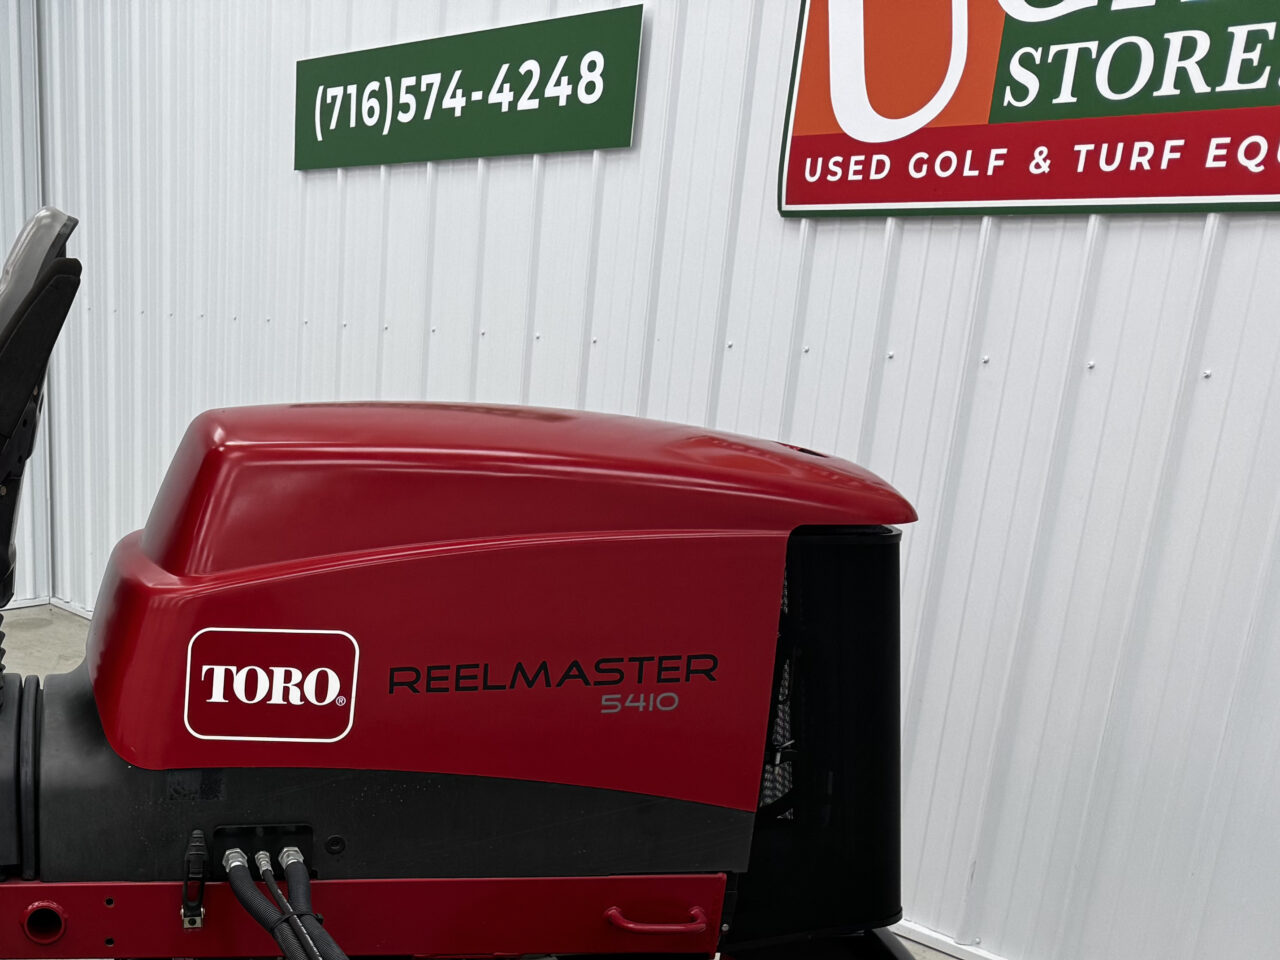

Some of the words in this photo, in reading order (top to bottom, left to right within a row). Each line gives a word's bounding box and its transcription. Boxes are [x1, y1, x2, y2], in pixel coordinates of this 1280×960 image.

[1003, 22, 1280, 108] STORE
[314, 50, 605, 142] (716)574-4248
[804, 154, 891, 183] USED
[908, 148, 1008, 179] GOLF
[1029, 146, 1051, 175] &
[1073, 139, 1185, 173] TURF
[1206, 134, 1280, 173] EQ
[388, 653, 719, 695] REELMASTER
[601, 692, 679, 714] 5410
